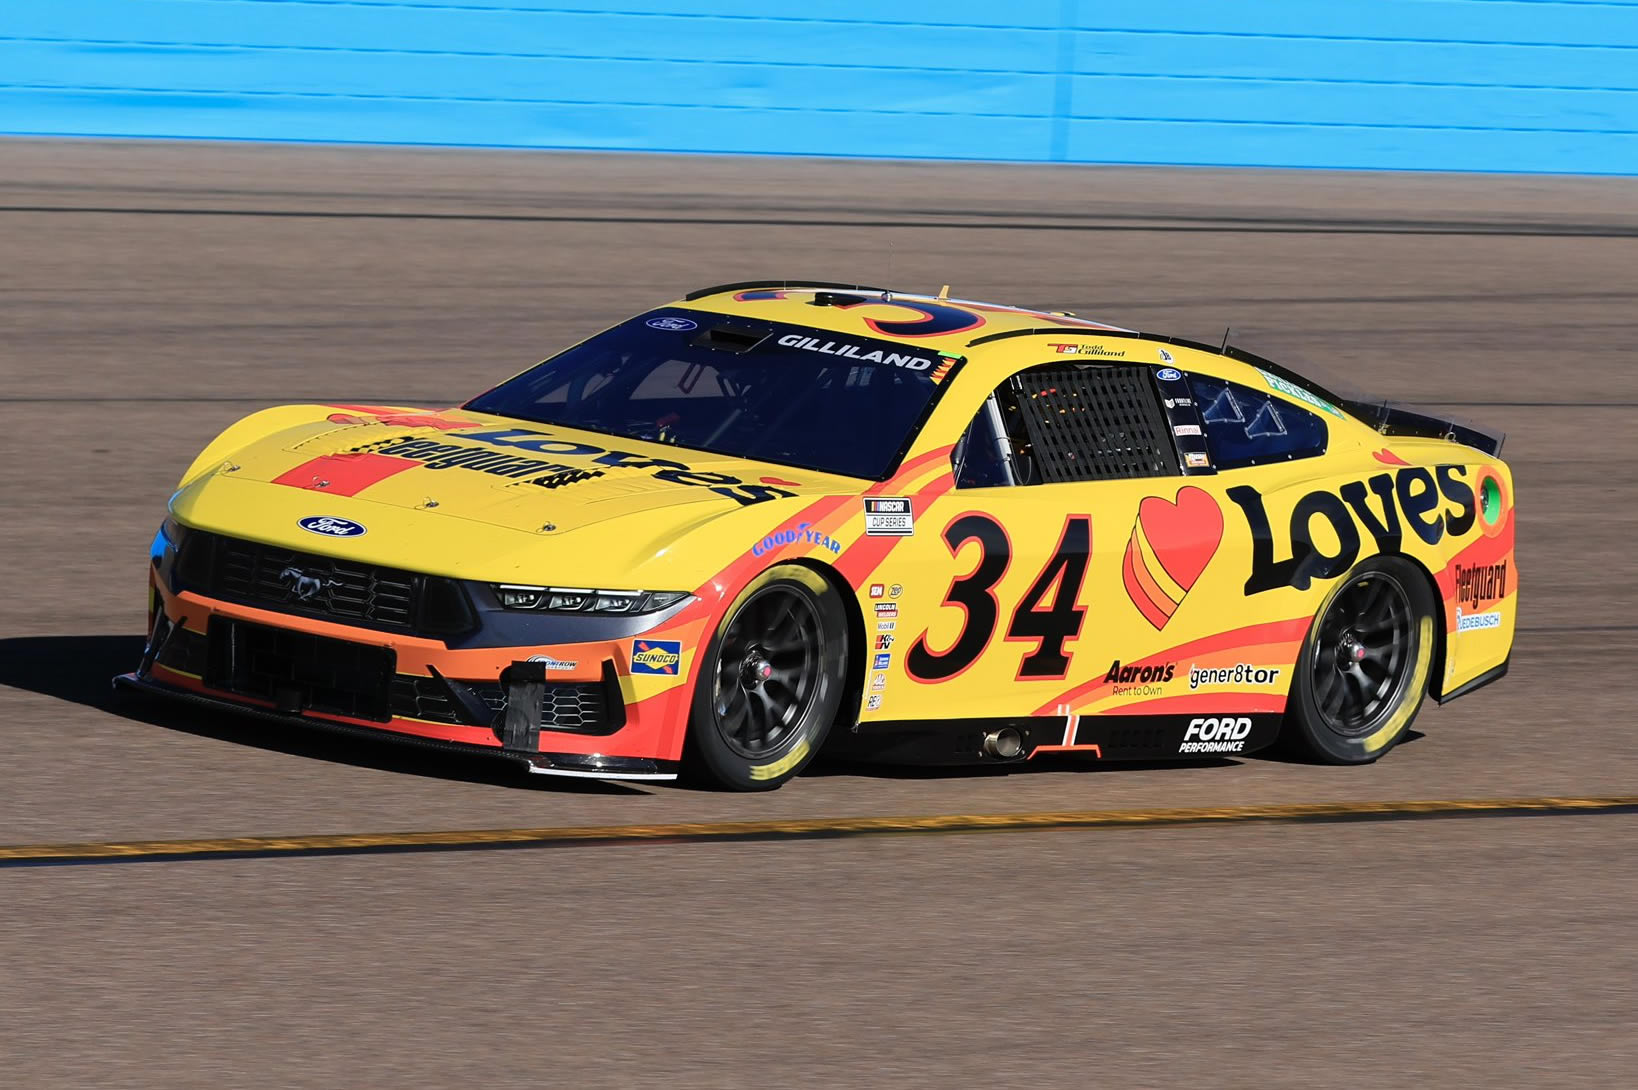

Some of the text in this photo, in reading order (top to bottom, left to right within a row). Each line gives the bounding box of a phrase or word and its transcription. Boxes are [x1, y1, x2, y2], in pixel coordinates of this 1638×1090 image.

[652, 319, 690, 330] Ford
[778, 334, 932, 371] GILLILAND
[1175, 426, 1199, 435] Rinnai
[879, 501, 904, 512] NASCAR
[308, 517, 355, 536] Ford
[872, 517, 906, 527] CUP SERIES
[1455, 560, 1507, 610] Fleetguard
[904, 510, 1092, 685] 34
[635, 653, 678, 664] SUNOCO
[1104, 660, 1176, 684] Aaron's
[1190, 664, 1279, 689] gener8tor
[1113, 685, 1162, 696] Rent to Own
[1184, 717, 1252, 741] FORD
[1179, 740, 1245, 753] PERFORMANCE
